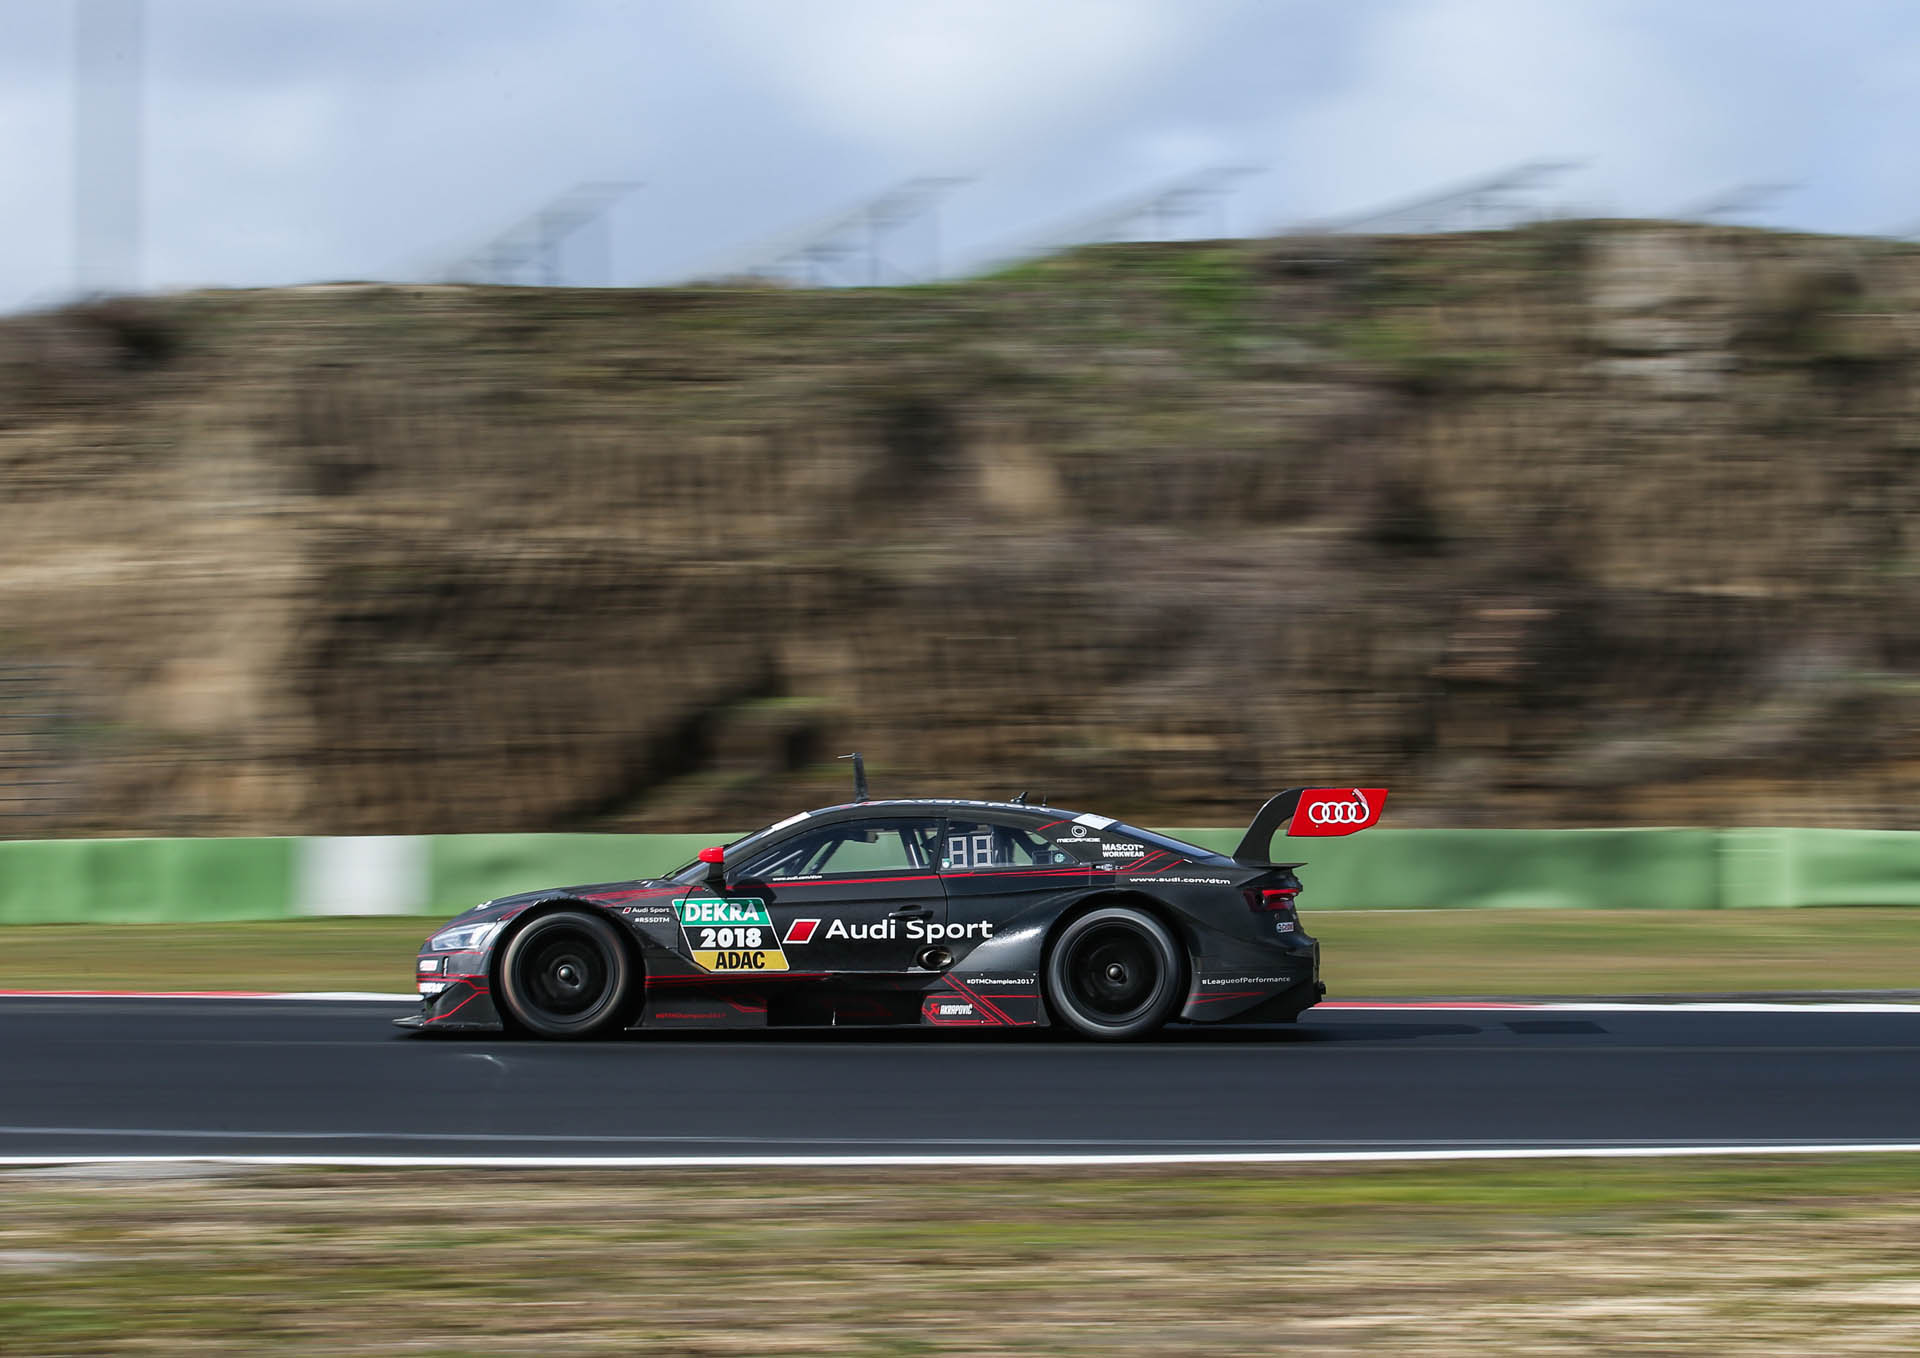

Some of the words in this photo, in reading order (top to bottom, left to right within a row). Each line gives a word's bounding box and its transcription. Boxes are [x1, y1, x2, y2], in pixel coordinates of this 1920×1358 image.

[1129, 877, 1231, 885] www.audi.com/dtm
[684, 902, 760, 922] DEKRA
[700, 928, 762, 948] 2018
[825, 919, 896, 939] Audi
[906, 920, 993, 944] Sport
[715, 951, 766, 969] ADAC
[1202, 977, 1291, 986] #LeagueofPerformance
